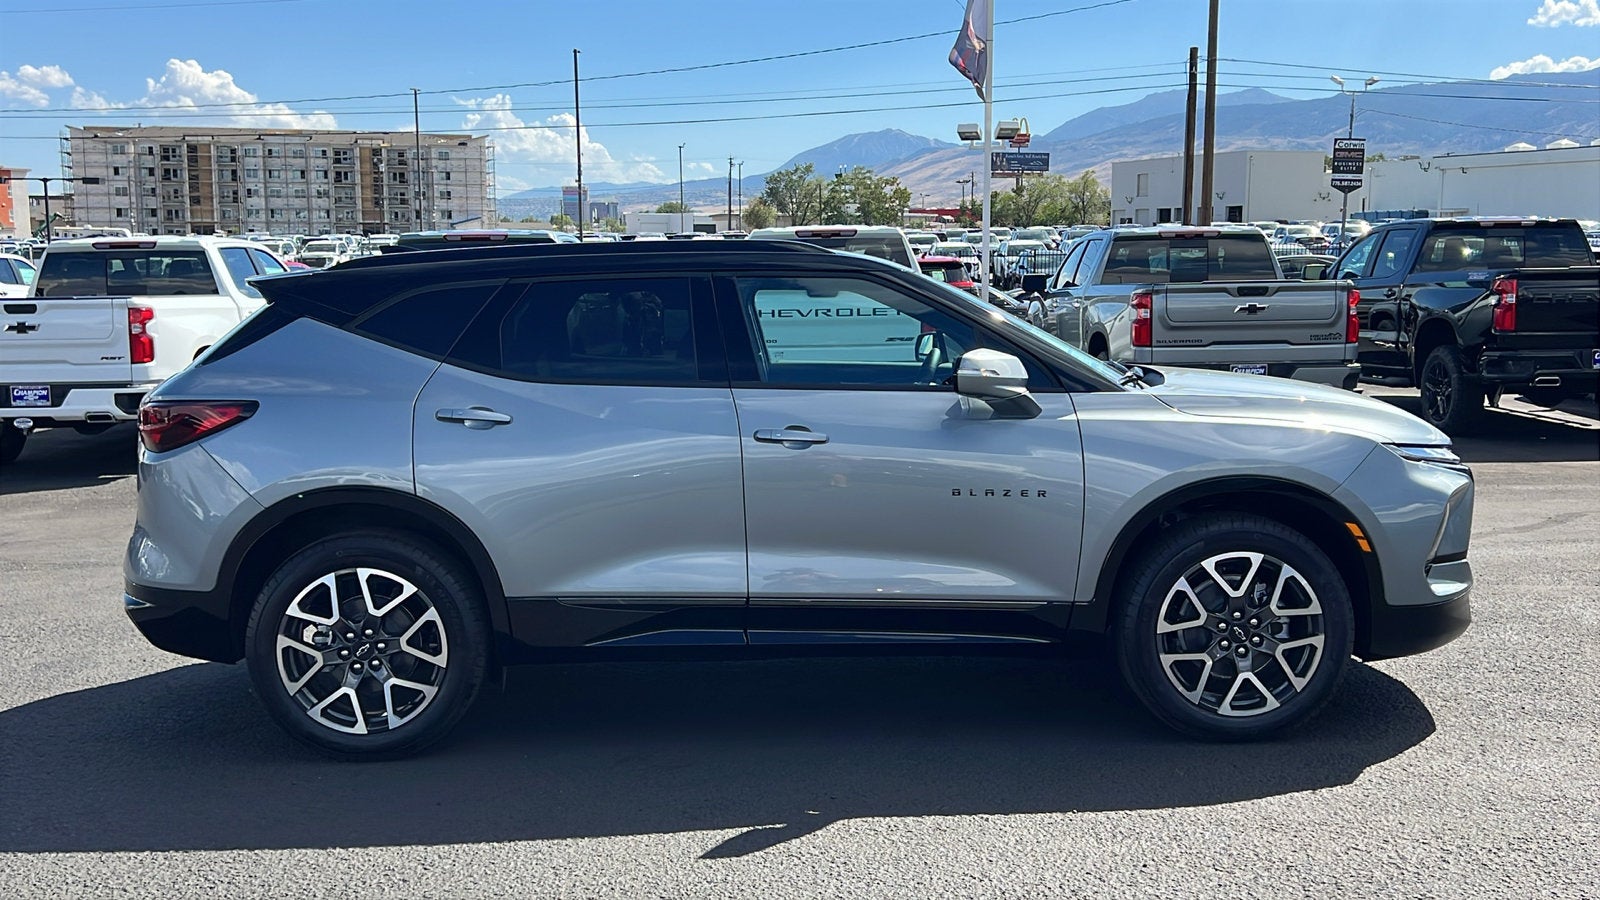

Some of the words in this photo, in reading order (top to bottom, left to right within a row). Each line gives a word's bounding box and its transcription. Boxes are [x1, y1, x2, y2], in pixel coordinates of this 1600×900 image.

[758, 307, 901, 318] HEVROLE
[13, 388, 48, 396] CHAMPION
[951, 488, 1048, 498] BLAZER
